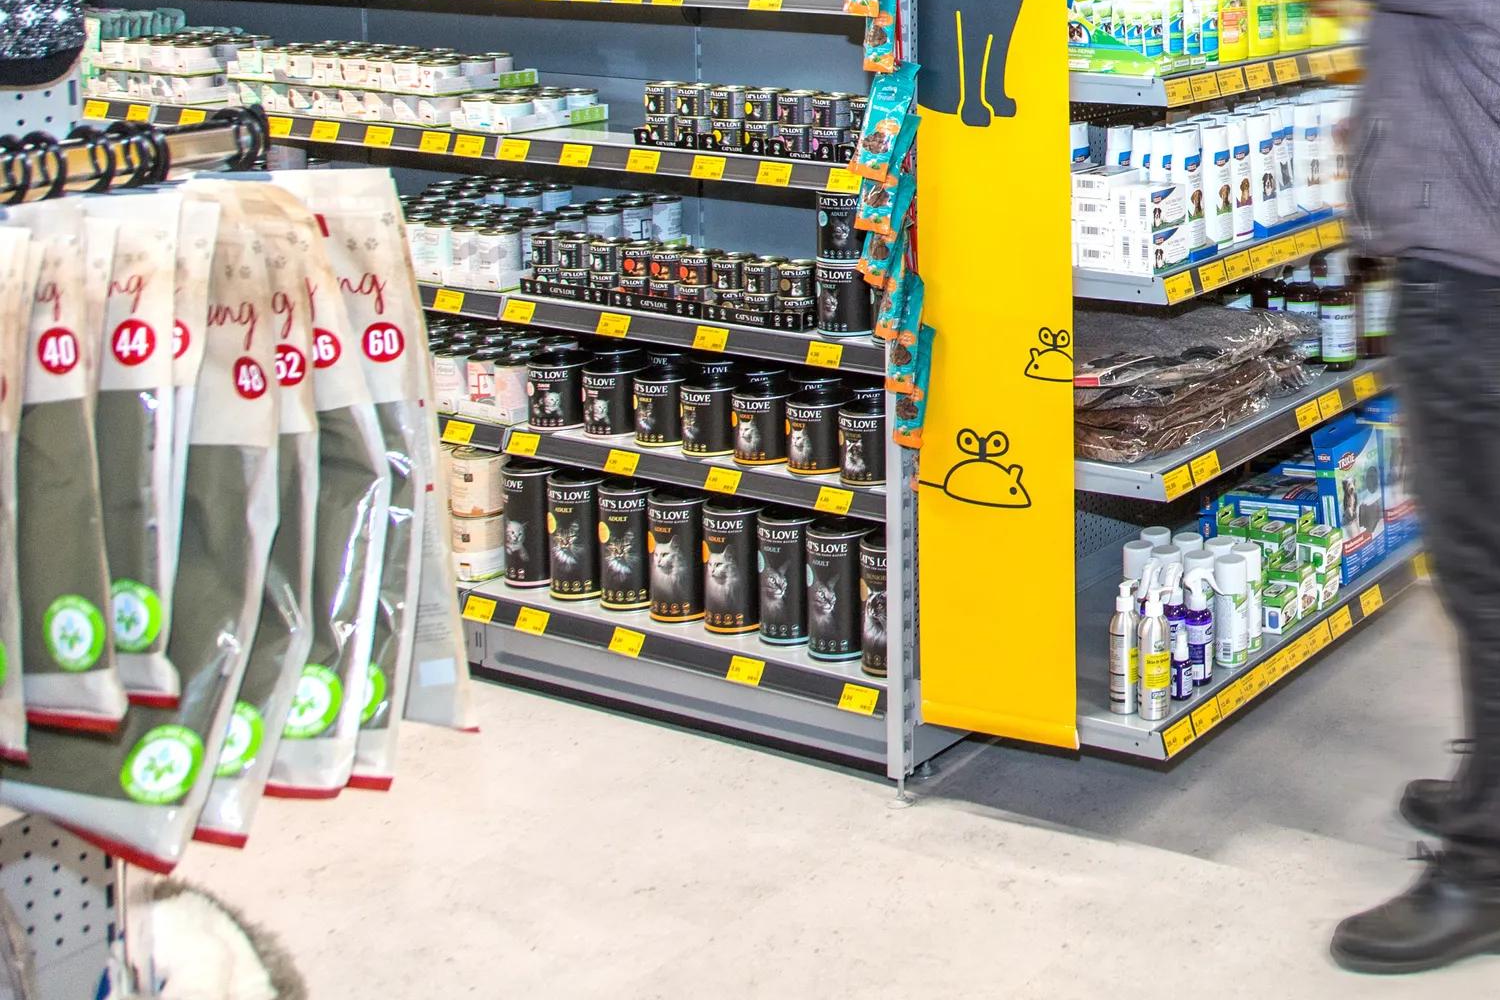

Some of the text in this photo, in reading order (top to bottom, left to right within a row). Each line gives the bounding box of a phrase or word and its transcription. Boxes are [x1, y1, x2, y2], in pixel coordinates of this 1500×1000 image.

[819, 197, 838, 206] CAT'S
[829, 271, 852, 280] LOVE
[115, 327, 148, 357] 44
[368, 331, 399, 354] 60
[43, 335, 76, 366] 40
[238, 366, 265, 392] 48
[544, 370, 568, 379] LOVE
[593, 378, 616, 386] LOVE
[645, 385, 668, 394] LOVE
[689, 394, 711, 403] LOVE
[746, 401, 770, 410] LOVE
[798, 410, 822, 418] LOVE
[853, 420, 877, 429] LOVE
[503, 480, 523, 490] LOVE
[548, 490, 591, 501] AT'S LOVE
[618, 498, 646, 509] LOVE
[650, 510, 690, 520] AT'S LOVE
[703, 519, 743, 530] AT'S LOVE
[772, 530, 799, 540] LOVE
[806, 542, 848, 553] AT'S LOVE
